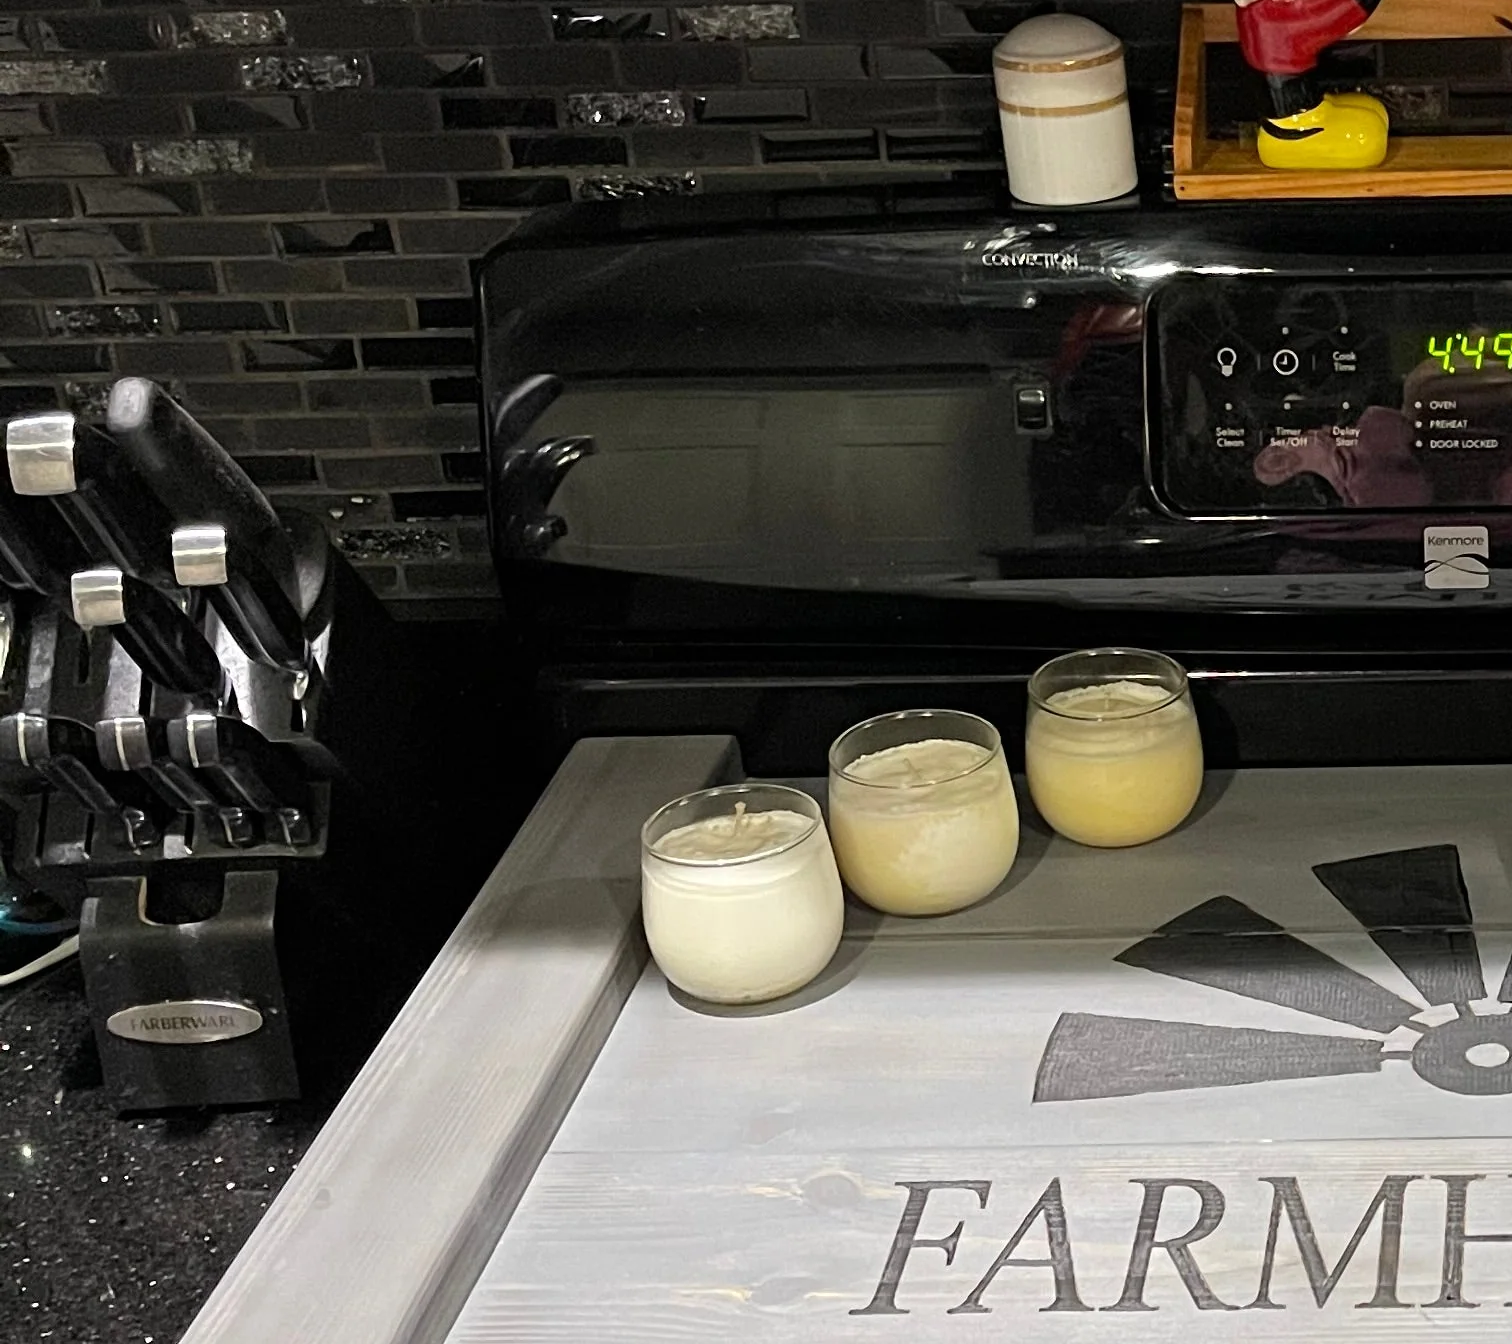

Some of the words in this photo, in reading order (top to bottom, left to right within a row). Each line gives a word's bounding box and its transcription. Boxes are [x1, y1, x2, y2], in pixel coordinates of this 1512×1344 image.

[981, 252, 1079, 270] CONVECTION
[1332, 351, 1357, 361] Cook
[1334, 362, 1356, 372] Time
[1429, 400, 1457, 410] OVEN
[1429, 419, 1468, 429] PREHEAT
[1215, 426, 1245, 436] Select
[1275, 426, 1302, 436] Timer
[1332, 425, 1361, 438] Delay
[1216, 438, 1245, 447] Clean
[1270, 437, 1308, 447] Set/Off
[1335, 437, 1359, 447] Start
[1430, 439, 1459, 449] DOOR
[1461, 439, 1498, 449] LOCKED
[1427, 536, 1484, 546] Kenmore
